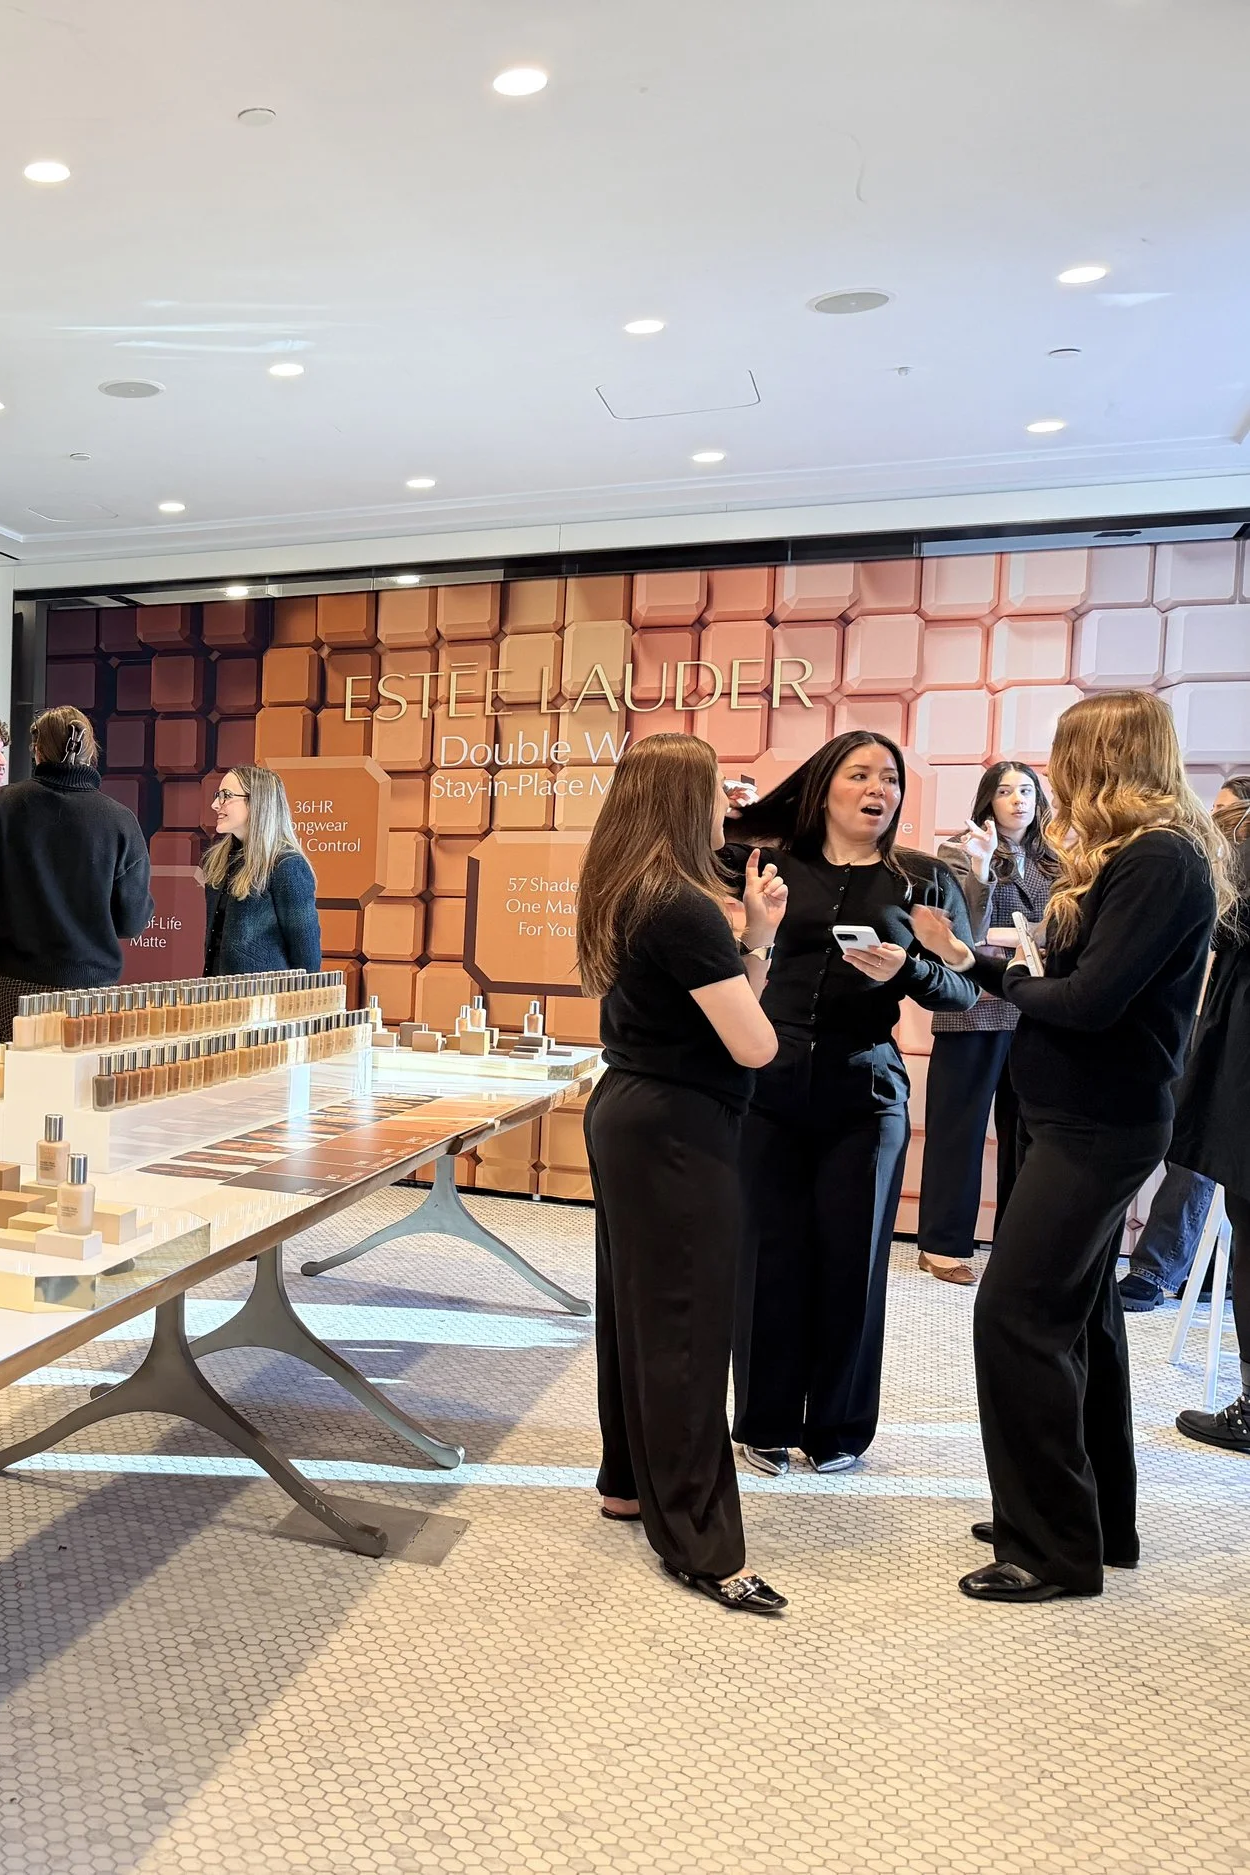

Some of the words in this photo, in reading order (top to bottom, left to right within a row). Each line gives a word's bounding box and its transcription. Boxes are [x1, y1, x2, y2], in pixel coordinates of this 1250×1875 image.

[540, 657, 815, 714] LAUDER
[440, 729, 572, 767] Double
[431, 773, 584, 804] Stay-in-Place
[293, 800, 334, 814] 36HR
[291, 819, 348, 836] ongwear
[306, 838, 361, 853] Control
[507, 877, 528, 892] 57
[530, 876, 580, 893] Shade
[506, 898, 541, 914] One
[518, 921, 544, 936] For
[130, 935, 167, 948] Matte
